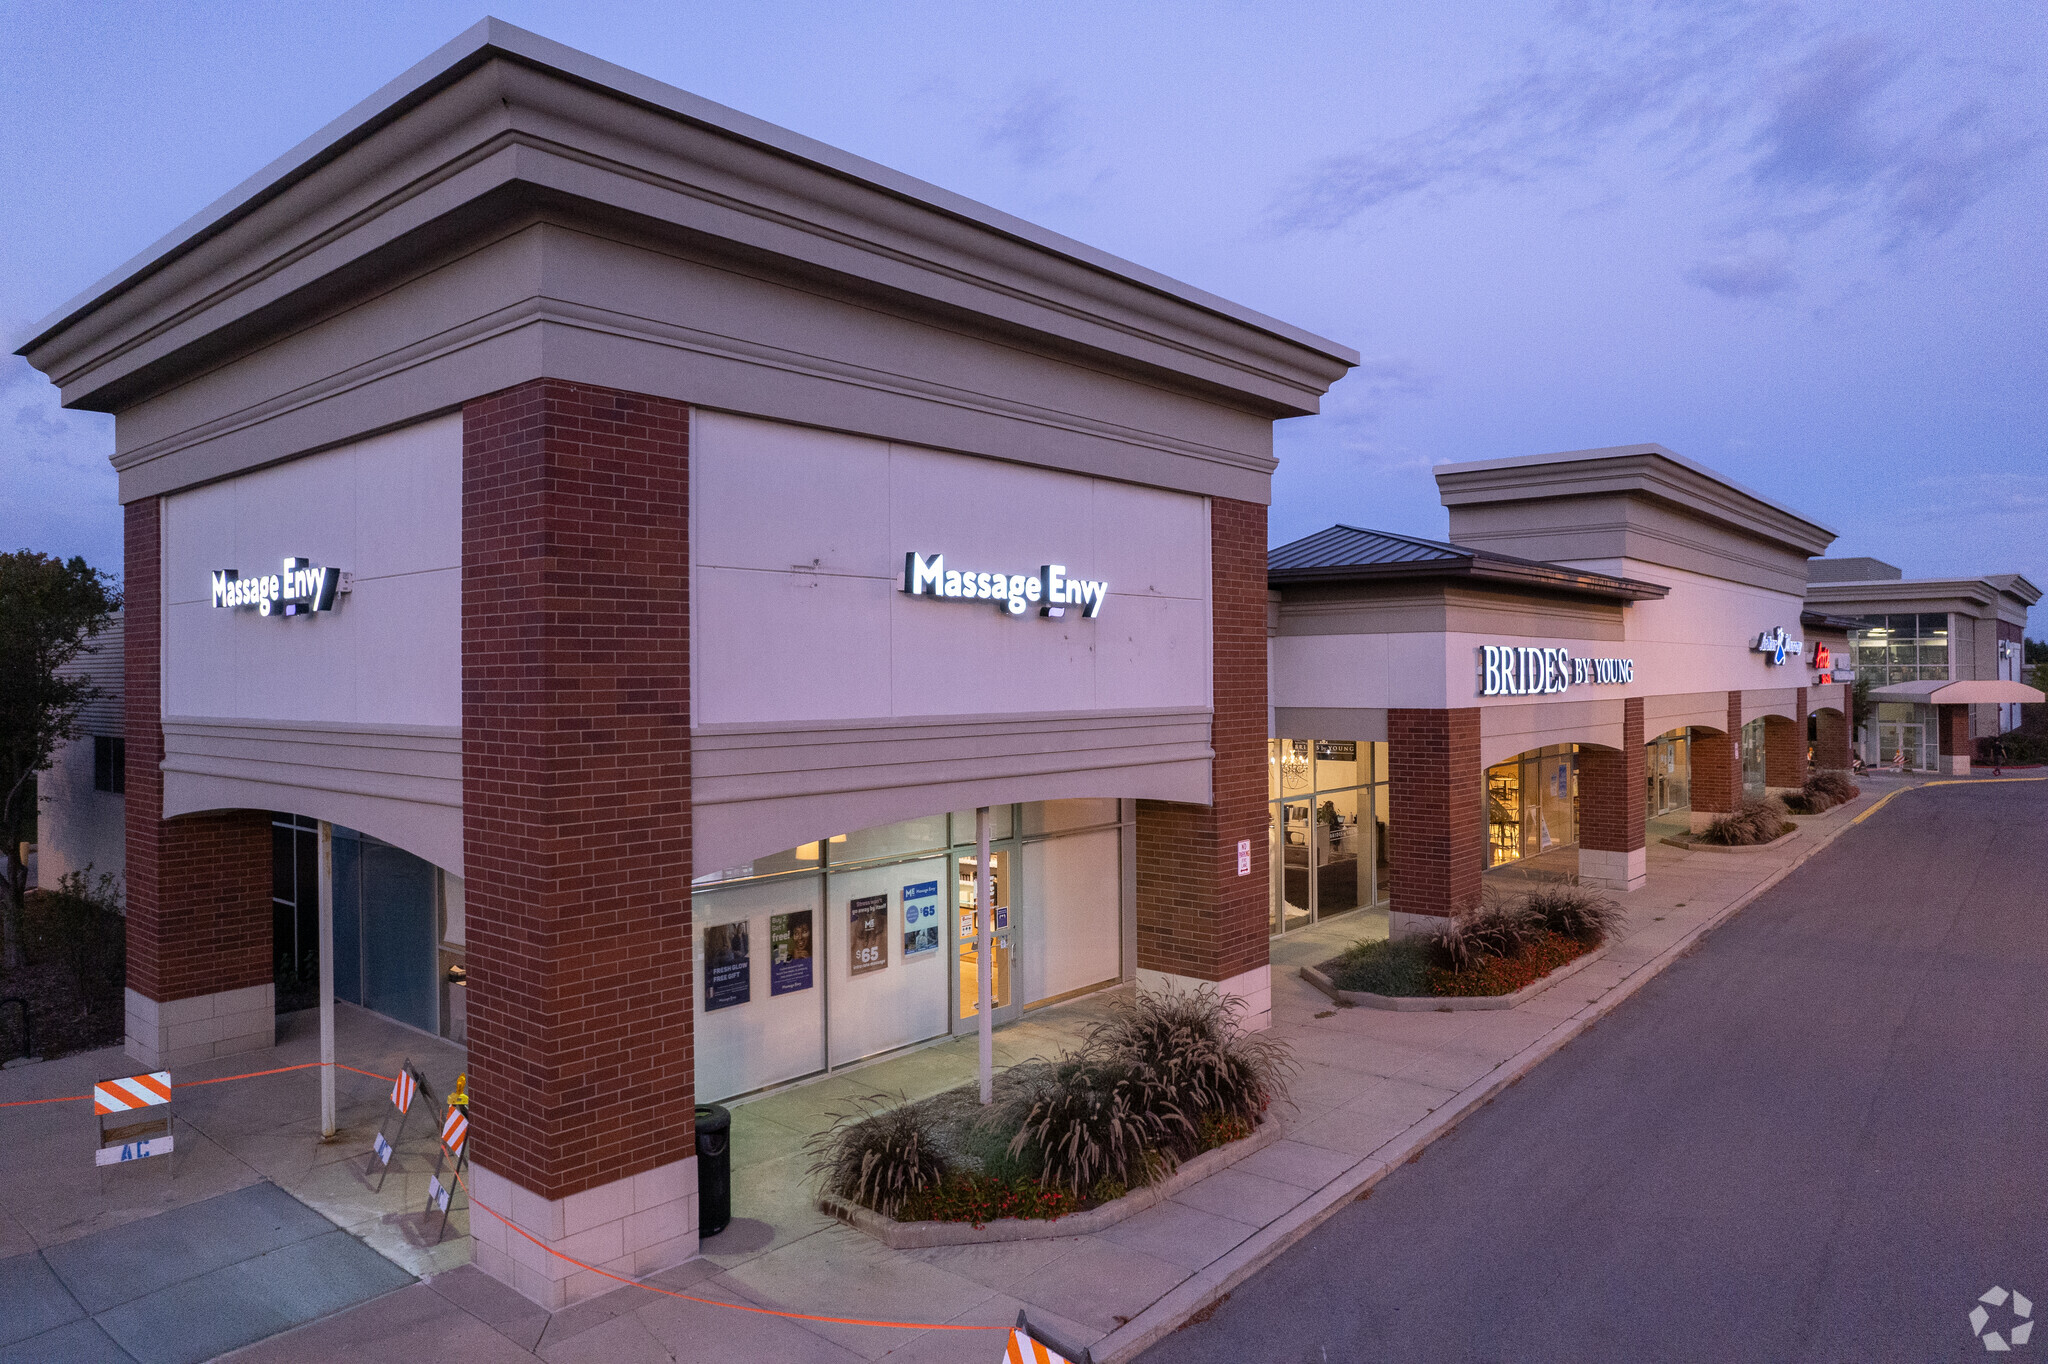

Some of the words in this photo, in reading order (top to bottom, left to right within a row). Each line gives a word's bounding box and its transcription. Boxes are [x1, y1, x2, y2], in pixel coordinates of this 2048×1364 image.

[212, 569, 280, 617] Massage
[283, 557, 327, 612] Envy
[911, 552, 1041, 614] Massage
[1049, 565, 1108, 618] Envy
[1483, 645, 1569, 695] BRIDES
[1575, 658, 1591, 684] BY
[1594, 658, 1634, 684] YOUNG
[920, 904, 936, 917] $65
[772, 930, 790, 942] free!
[856, 946, 879, 963] $65
[713, 966, 732, 975] FRESH
[732, 962, 748, 970] GLOW
[713, 974, 728, 982] FREE
[728, 971, 740, 979] GIFT
[121, 1140, 150, 1161] AC
